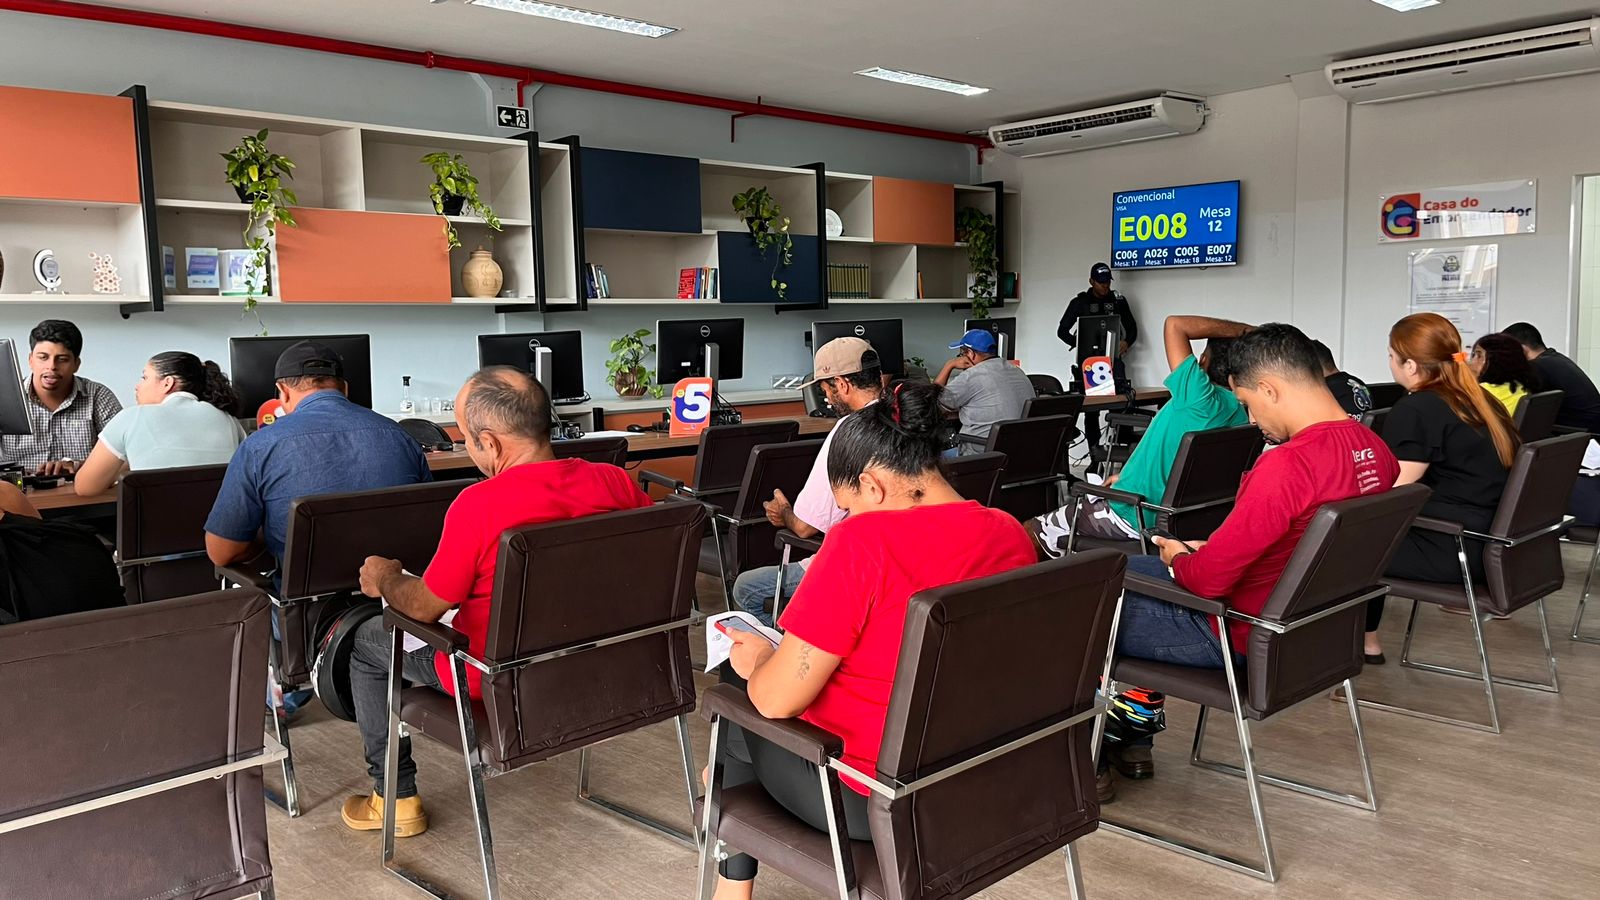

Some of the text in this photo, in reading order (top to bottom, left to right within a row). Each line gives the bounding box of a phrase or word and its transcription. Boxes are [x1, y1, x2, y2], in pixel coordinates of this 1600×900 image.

[1116, 189, 1176, 204] Convencional
[1423, 197, 1479, 211] Casa do
[1199, 206, 1231, 219] Mesa
[1119, 212, 1187, 242] E008
[1207, 220, 1222, 232] 12
[1115, 250, 1138, 260] C006
[1144, 248, 1168, 259] A026
[1174, 246, 1199, 257] C005
[1207, 244, 1232, 255] E007
[1091, 361, 1113, 386] 8
[682, 383, 711, 420] 5
